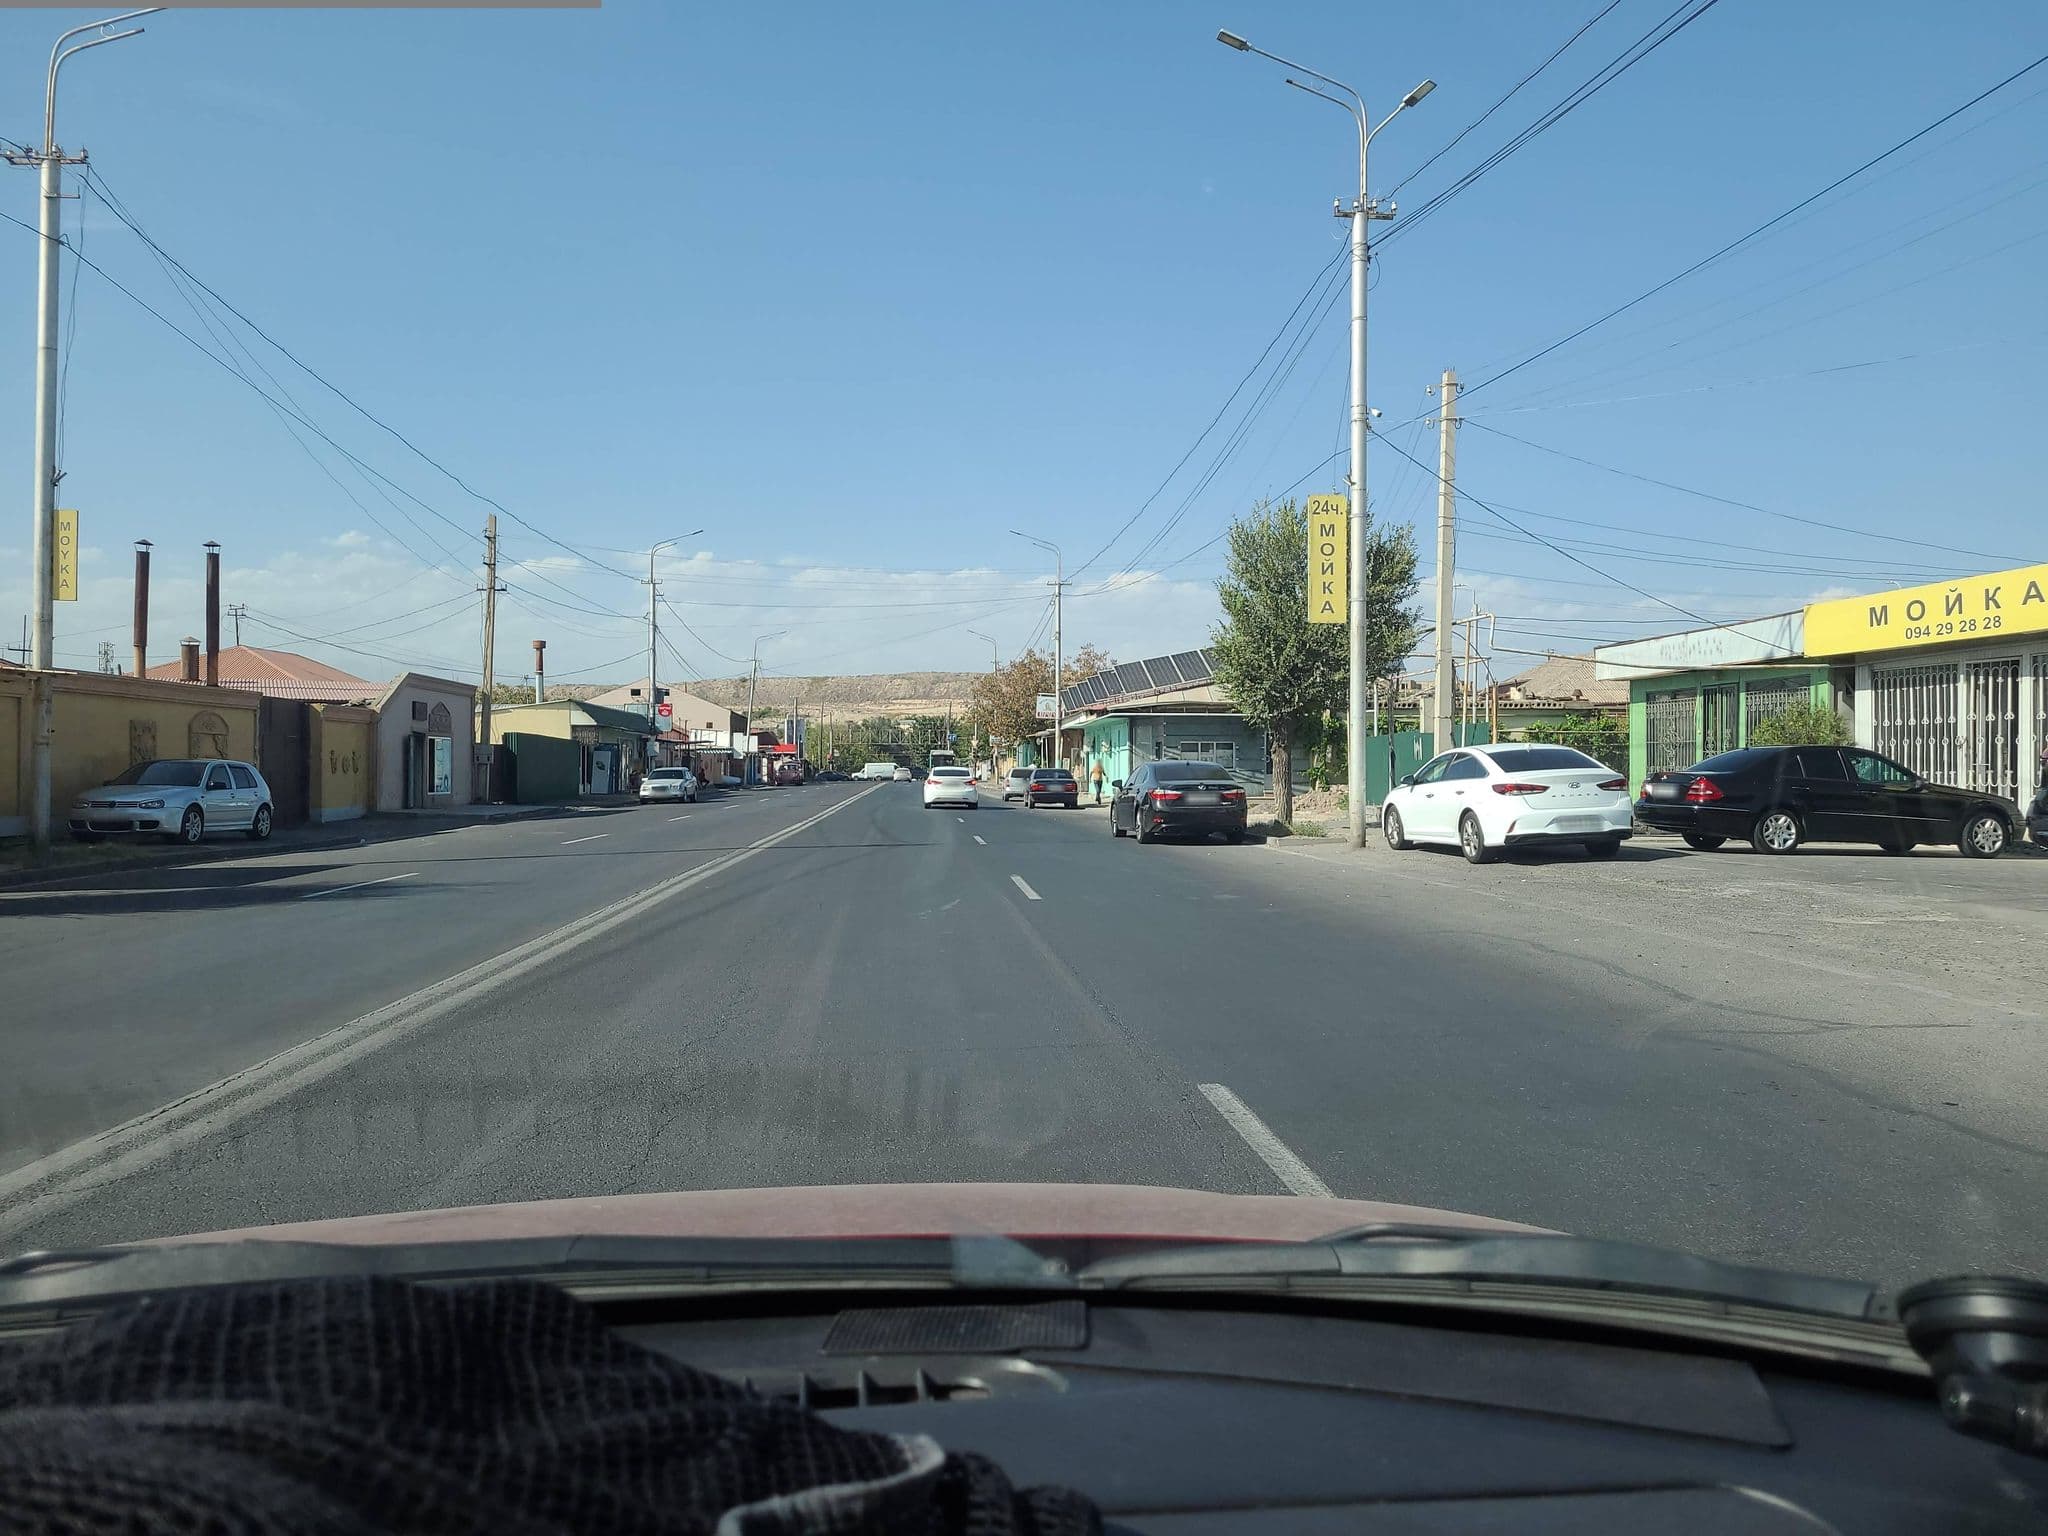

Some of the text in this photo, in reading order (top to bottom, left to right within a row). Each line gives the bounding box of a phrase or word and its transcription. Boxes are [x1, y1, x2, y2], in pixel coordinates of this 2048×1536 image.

[1312, 500, 1344, 515] 24ч.
[60, 521, 71, 588] MOYKA
[1320, 523, 1335, 614] МОЙКА
[1869, 580, 2046, 627] МОЙКА
[1905, 615, 2002, 640] 094 29 28 28
